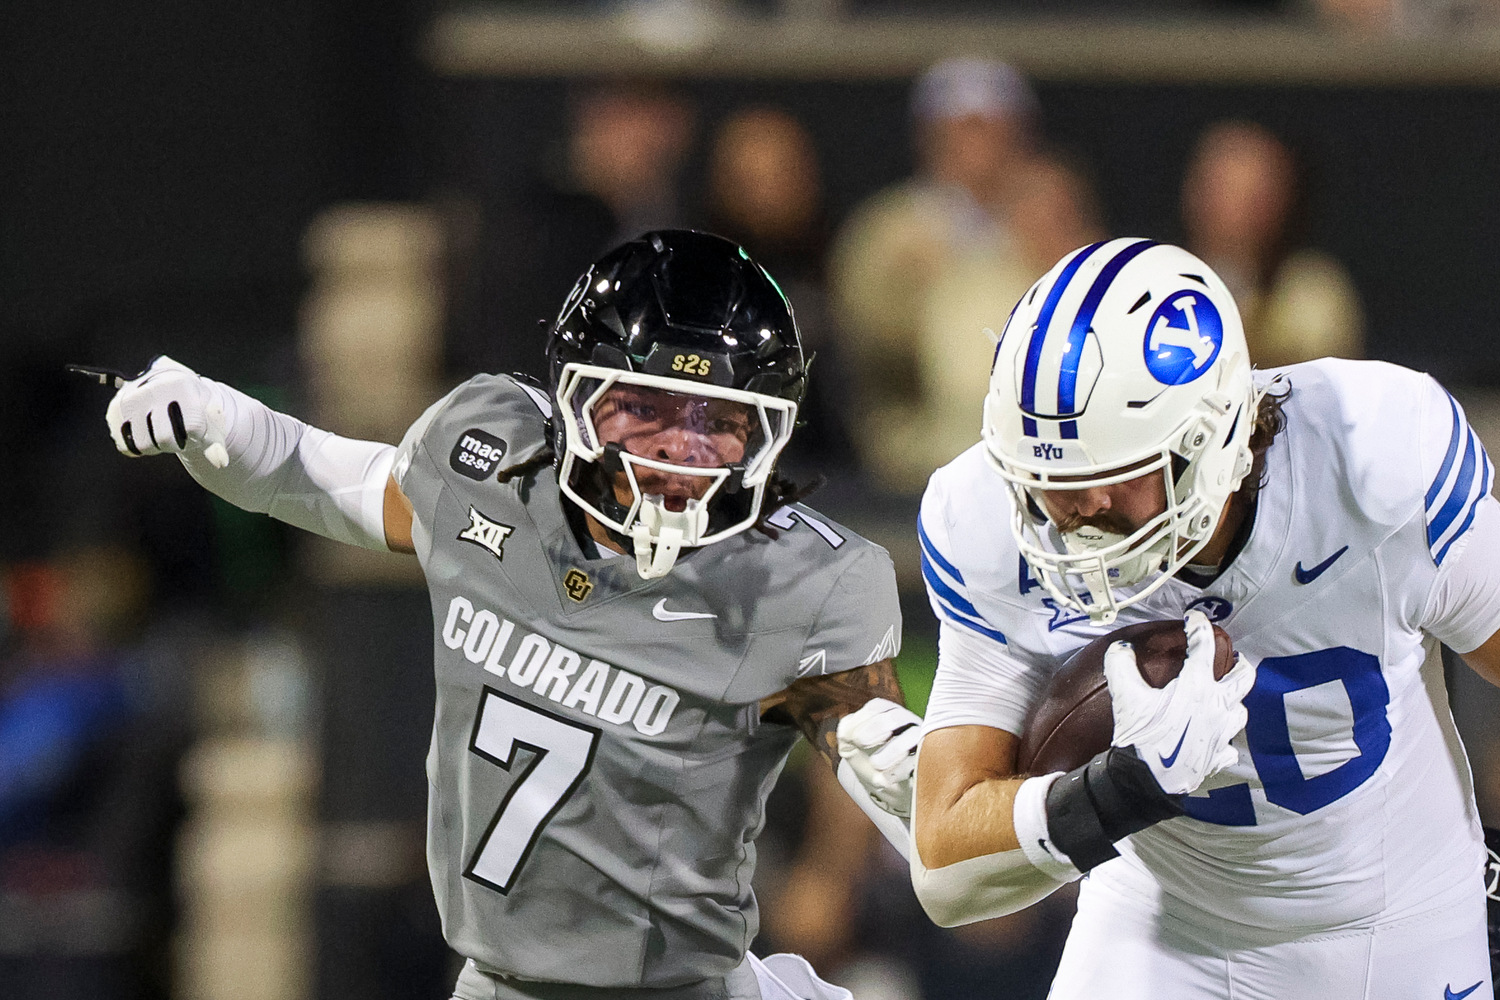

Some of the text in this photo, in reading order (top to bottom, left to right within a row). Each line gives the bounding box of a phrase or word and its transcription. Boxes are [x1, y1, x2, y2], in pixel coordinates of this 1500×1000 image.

[458, 451, 491, 472] 82-94
[460, 434, 503, 462] mac
[1033, 443, 1063, 460] BYU
[766, 504, 847, 550] 7
[442, 596, 681, 736] COLORADO
[461, 682, 604, 897] 7
